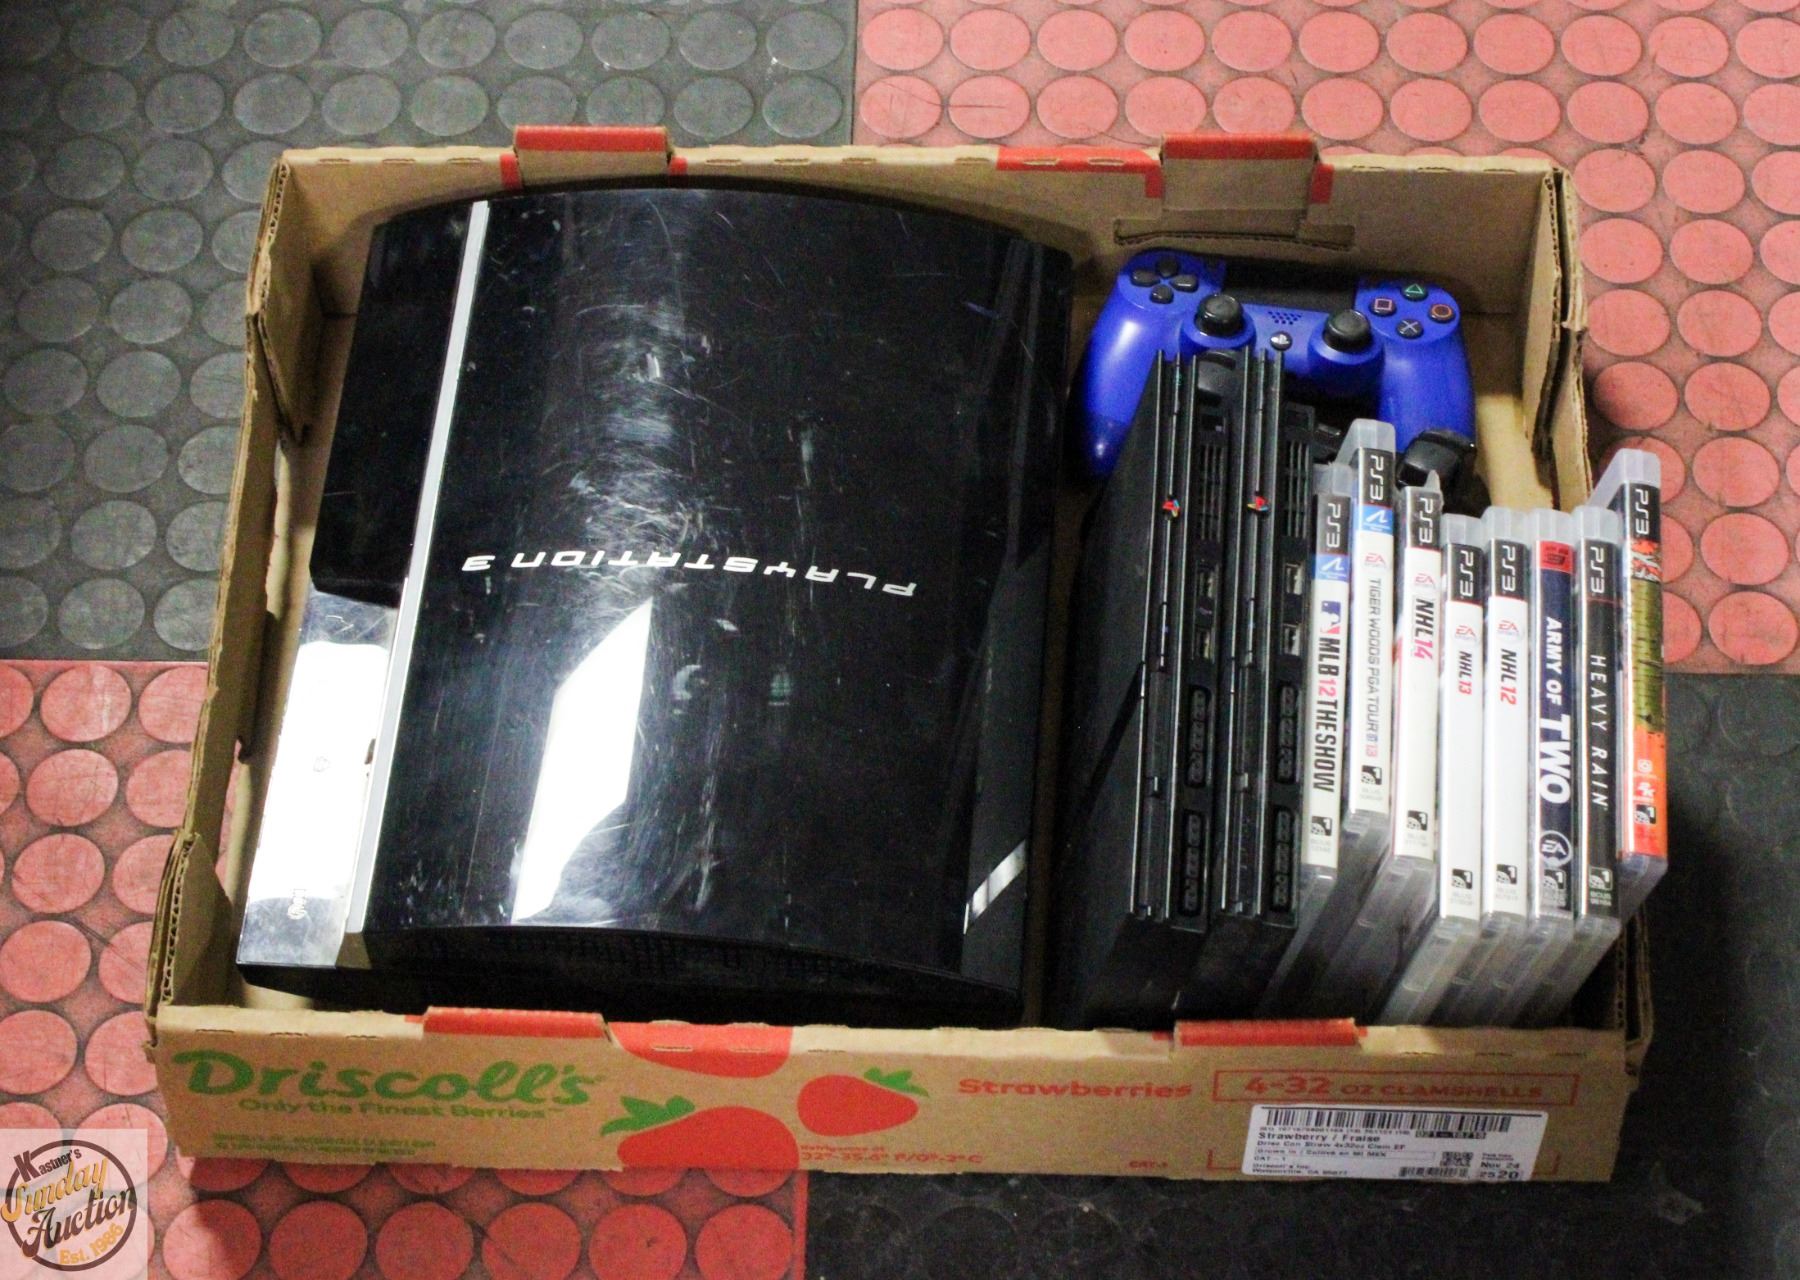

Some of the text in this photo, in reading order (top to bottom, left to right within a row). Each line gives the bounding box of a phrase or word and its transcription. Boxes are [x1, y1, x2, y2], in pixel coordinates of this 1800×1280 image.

[1369, 455, 1384, 501] PS3
[1326, 503, 1341, 549] PS3
[1418, 497, 1435, 544] PS3
[1635, 489, 1649, 535] PS3
[461, 550, 916, 596] PLAYSTATION 3
[1459, 550, 1474, 597] PS3
[1501, 545, 1516, 592] PS3
[1590, 547, 1605, 594] PS3
[1367, 578, 1382, 616] TIGER
[1415, 598, 1435, 638] NHL
[1318, 637, 1341, 677] MLB
[1367, 618, 1381, 665] WOODS
[1413, 639, 1433, 660] 14
[1367, 667, 1380, 695] PGA
[1458, 651, 1472, 680] NHL
[1500, 649, 1517, 684] NHL
[1318, 679, 1337, 697] 12
[1458, 681, 1472, 695] 13
[1500, 685, 1517, 705] 12
[1366, 695, 1379, 733] TOUR
[1540, 617, 1571, 804] ARMY OF TWO
[1590, 654, 1609, 807] HEAVY RAIN
[172, 1050, 598, 1105] Driscoll's
[958, 1078, 1193, 1098] Strawberries
[1245, 1075, 1543, 1099] 4-32 OZ CLAMSHELLS
[238, 1099, 546, 1119] Only the Finest Berries
[1258, 1131, 1328, 1142] Strawberry
[1342, 1134, 1380, 1142] Fraise
